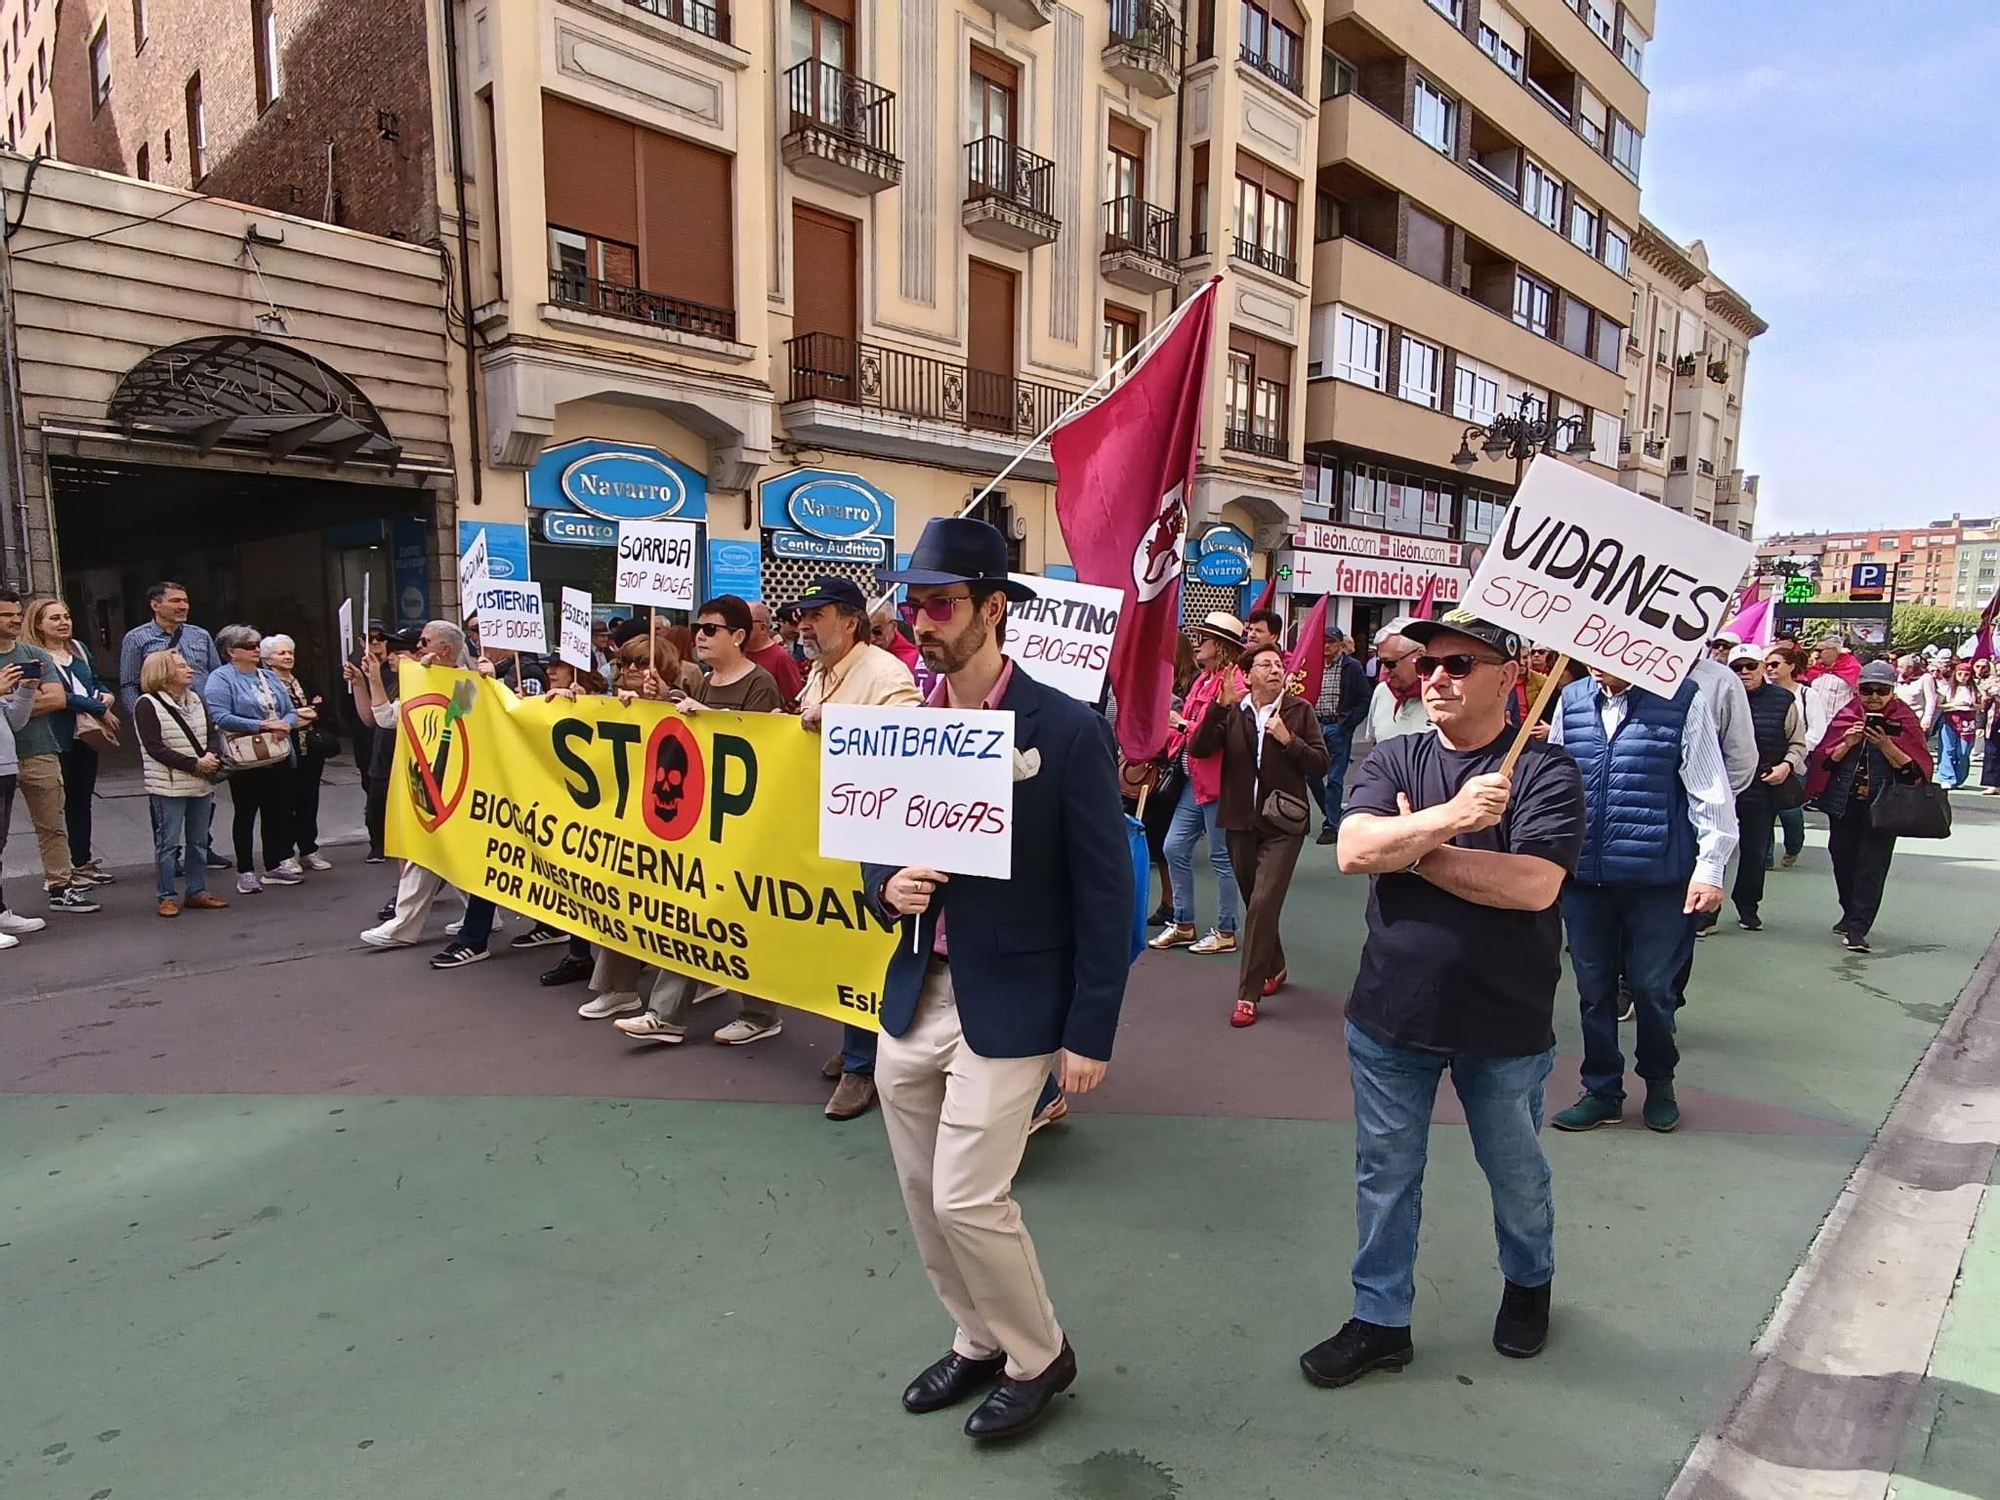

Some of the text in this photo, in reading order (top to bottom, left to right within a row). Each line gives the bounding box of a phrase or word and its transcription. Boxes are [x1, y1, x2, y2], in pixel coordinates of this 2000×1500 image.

[579, 473, 671, 502] Navarro
[553, 519, 613, 538] Centro
[801, 498, 870, 522] Navarro
[619, 535, 691, 569] SORRIBA
[780, 537, 880, 557] Centro Auditivo
[619, 571, 693, 600] STOP BIOGAS
[1201, 565, 1242, 577] Navarro
[1336, 559, 1459, 600] farmacia siera
[1503, 506, 1729, 642] VIDANES
[1860, 565, 1878, 587] P
[477, 589, 539, 615] CISTIERNA
[1007, 598, 1118, 635] MARTINO
[507, 619, 544, 640] BIOGAS
[1482, 576, 1684, 683] STOP BIOGAS
[1022, 634, 1109, 671] BIOGAS
[828, 722, 1005, 760] SANTIBAÑEZ
[552, 717, 758, 844] STOP
[827, 783, 1005, 835] STOP BIOGAS
[469, 789, 558, 847] BIOGÁS
[562, 822, 707, 900] CISTIERNA
[734, 870, 895, 934] VIDAN
[486, 837, 749, 949] POR NUESTROS PUEBLOS
[484, 866, 750, 981] POR NUESTRAS TIERRAS
